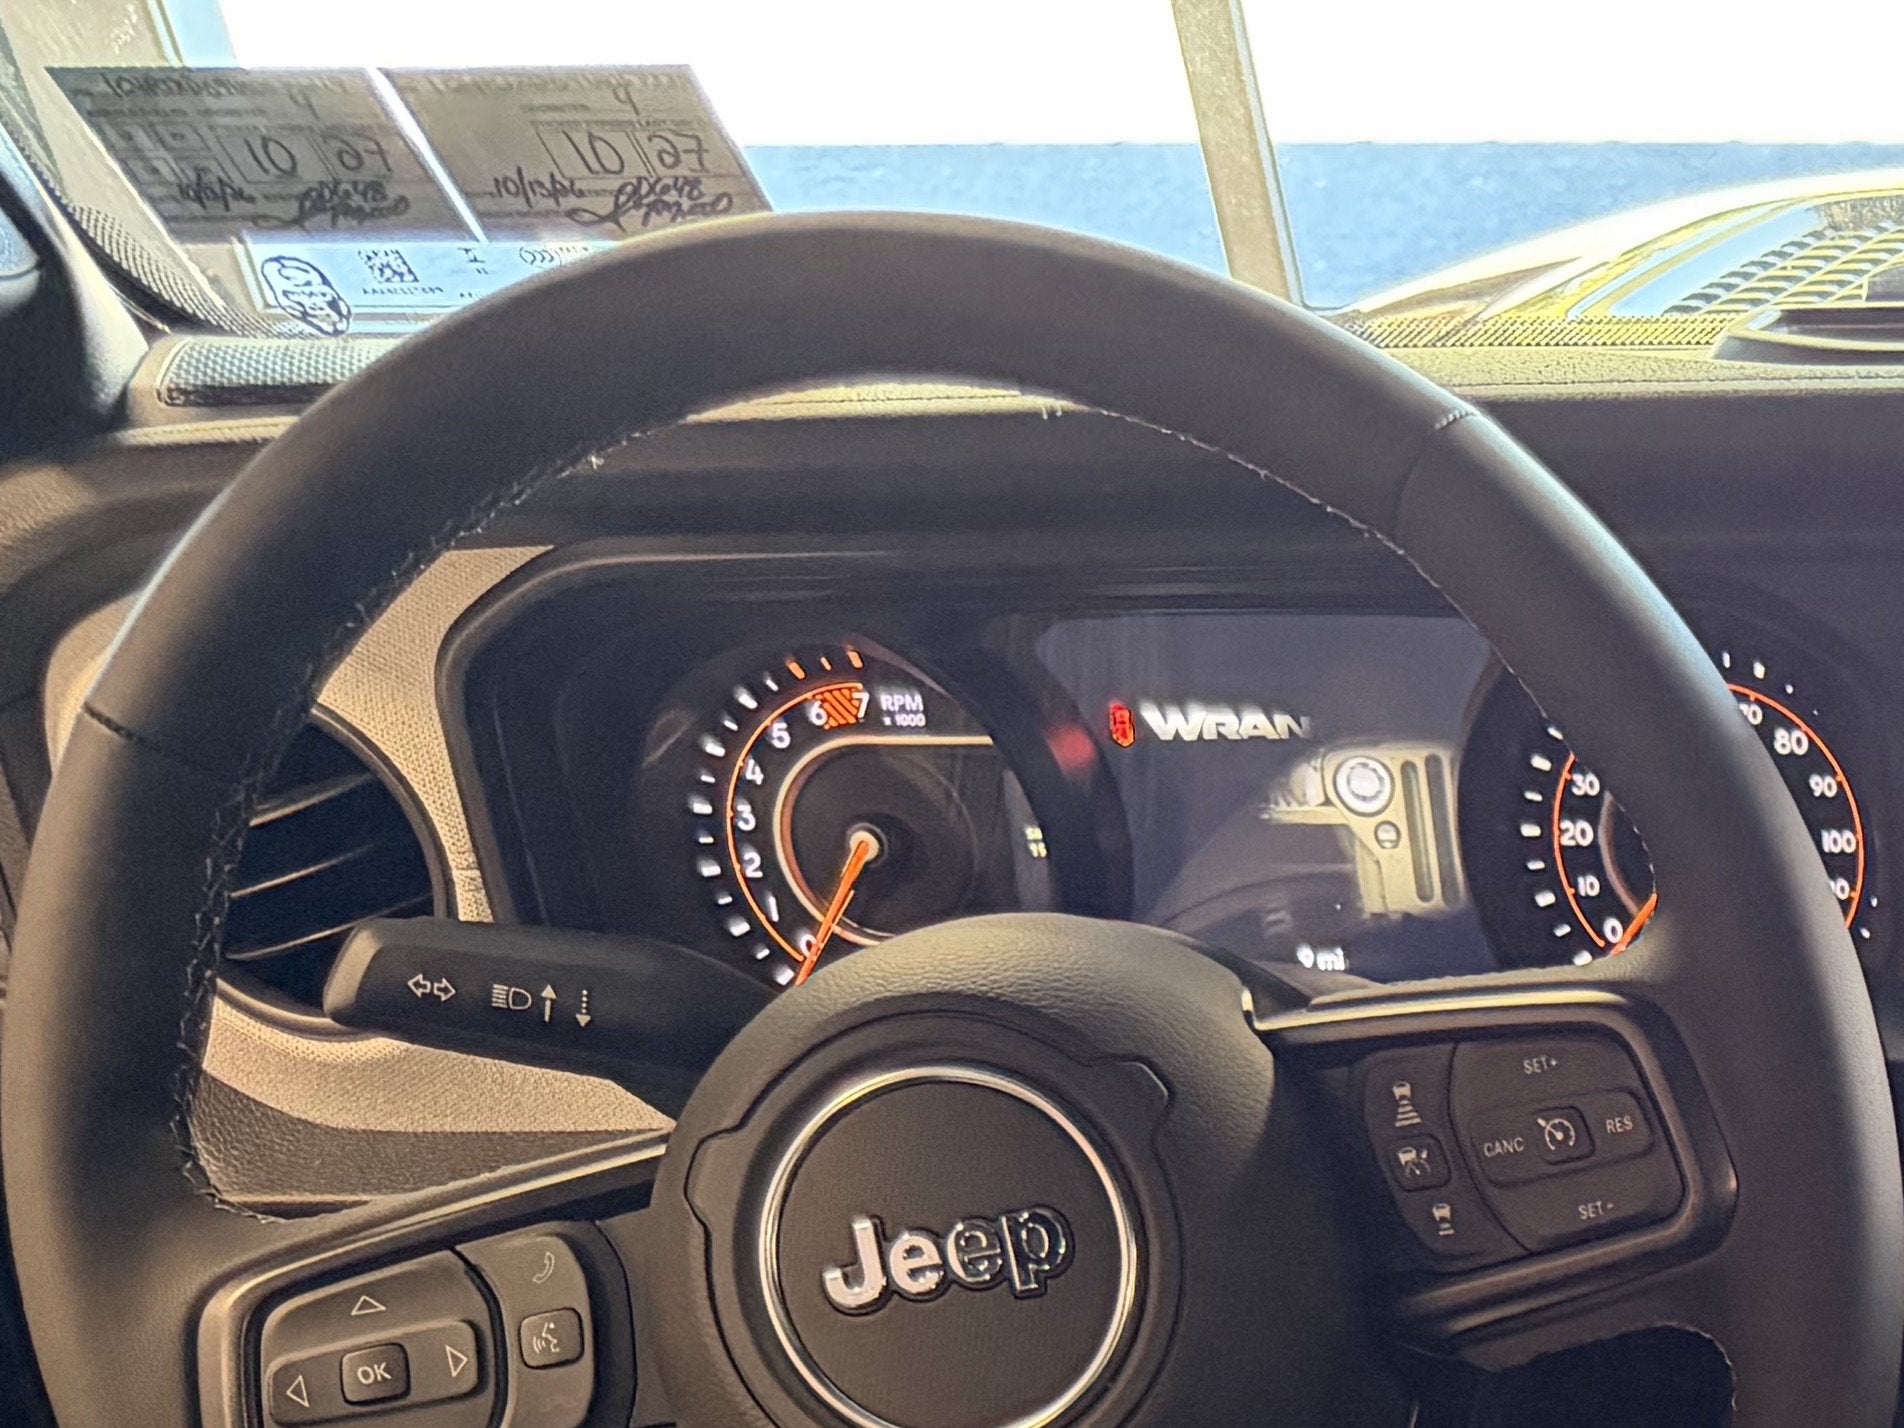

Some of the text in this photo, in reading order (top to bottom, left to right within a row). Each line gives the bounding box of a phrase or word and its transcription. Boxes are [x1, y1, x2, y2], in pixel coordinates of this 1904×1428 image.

[244, 136, 298, 178] 10
[562, 130, 624, 175] 10
[810, 700, 828, 726] 6
[855, 692, 870, 720] 7
[880, 693, 925, 713] RPM
[895, 713, 927, 727] 1000
[770, 722, 791, 749] 5
[1774, 727, 1809, 756] 80
[745, 761, 764, 785] 4
[1571, 773, 1600, 796] 30
[1809, 773, 1838, 797] 90
[736, 805, 756, 832] 3
[1560, 820, 1594, 847] 20
[1821, 829, 1857, 854] 100
[743, 853, 764, 878] 2
[1577, 876, 1600, 897] 10
[1603, 918, 1624, 943] 0
[1605, 1115, 1634, 1134] RES
[1484, 1137, 1525, 1157] CANC
[822, 1206, 1074, 1316] Jeep
[357, 1364, 391, 1385] OK
